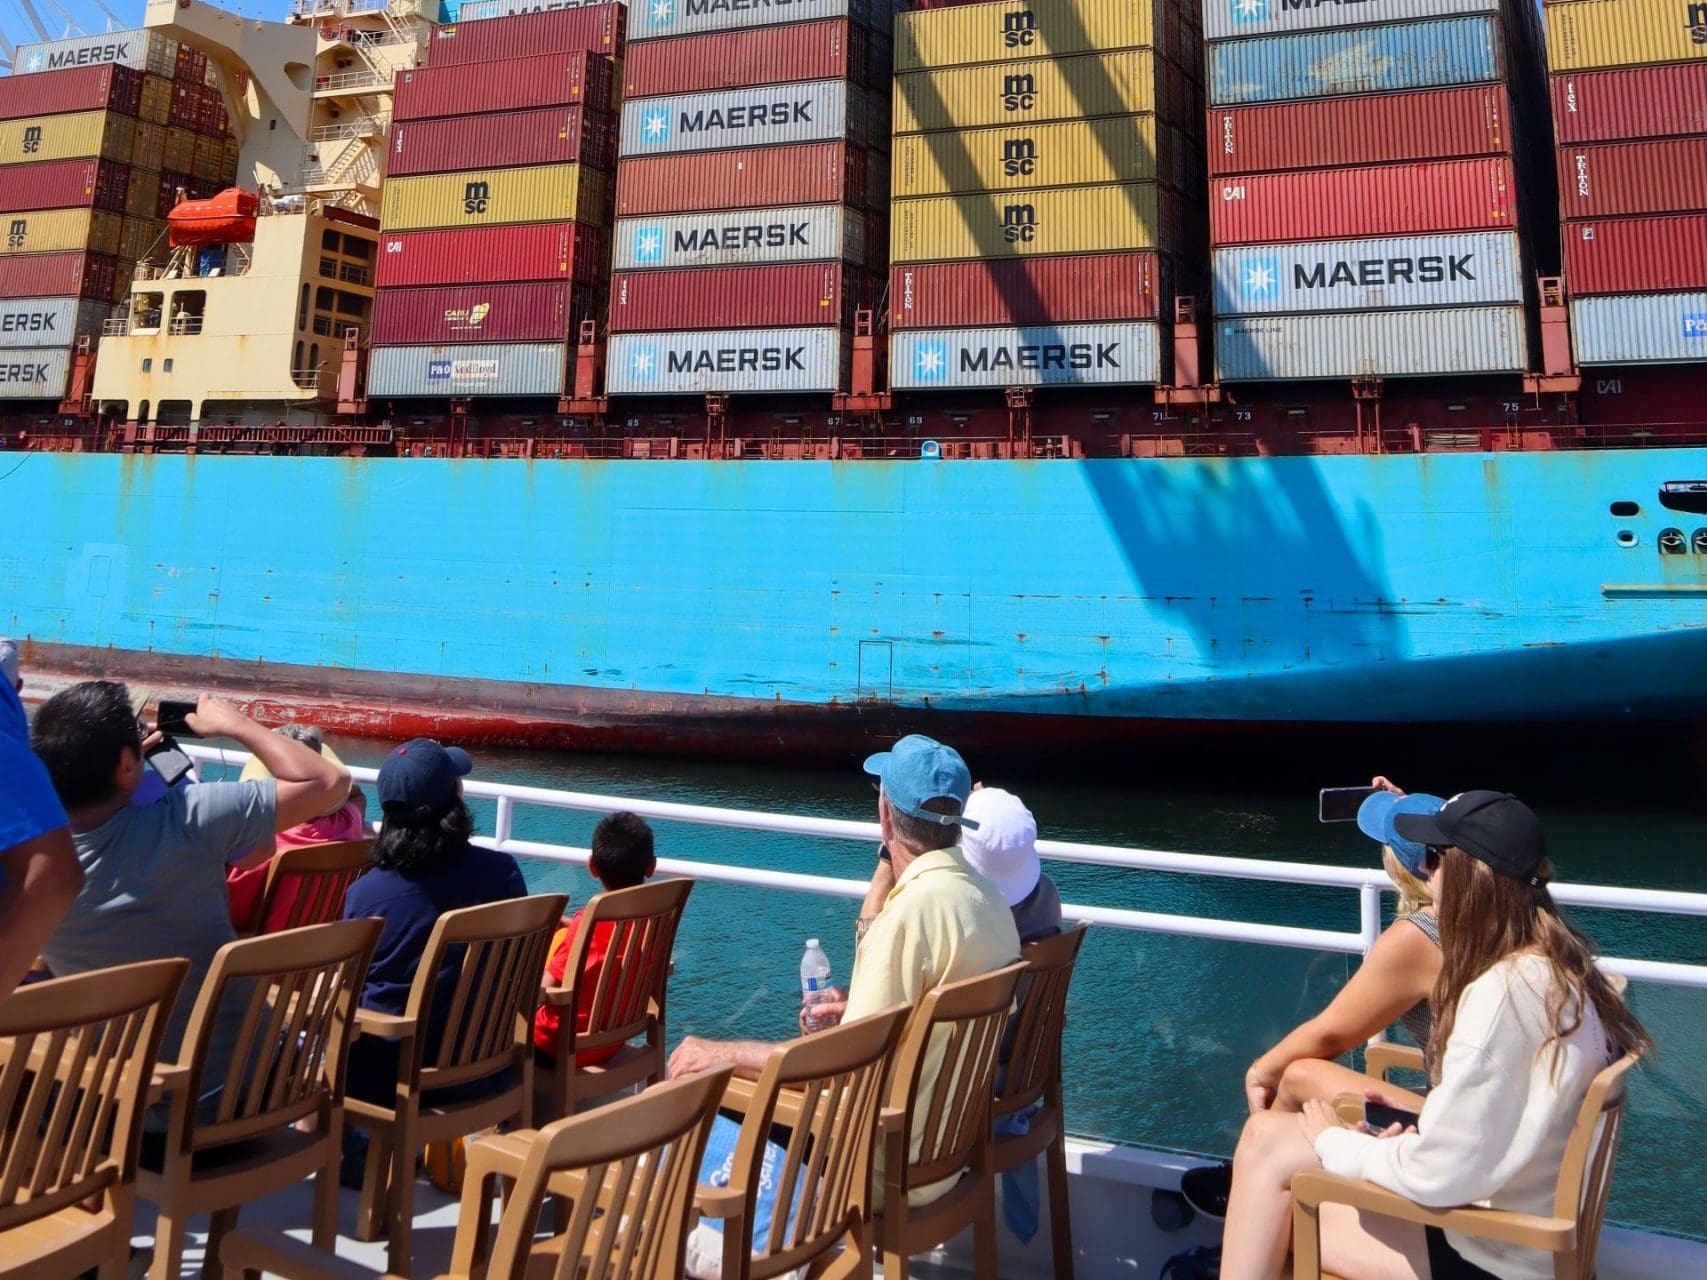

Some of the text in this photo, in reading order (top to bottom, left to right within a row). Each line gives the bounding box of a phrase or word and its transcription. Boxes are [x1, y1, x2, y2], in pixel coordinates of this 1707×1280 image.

[48, 43, 129, 68] MAERSK
[680, 100, 813, 133] MAERSK
[1223, 116, 1234, 154] TRITON
[1576, 155, 1588, 196] TRITON
[1223, 186, 1245, 200] CAI
[674, 223, 809, 252] MAERSK
[1294, 254, 1476, 289] MAERSK
[905, 273, 913, 309] TRITON
[668, 347, 806, 373] MAERSK
[960, 342, 1120, 372] MAERSK
[1236, 412, 1251, 420] 73
[1503, 403, 1519, 412] 75
